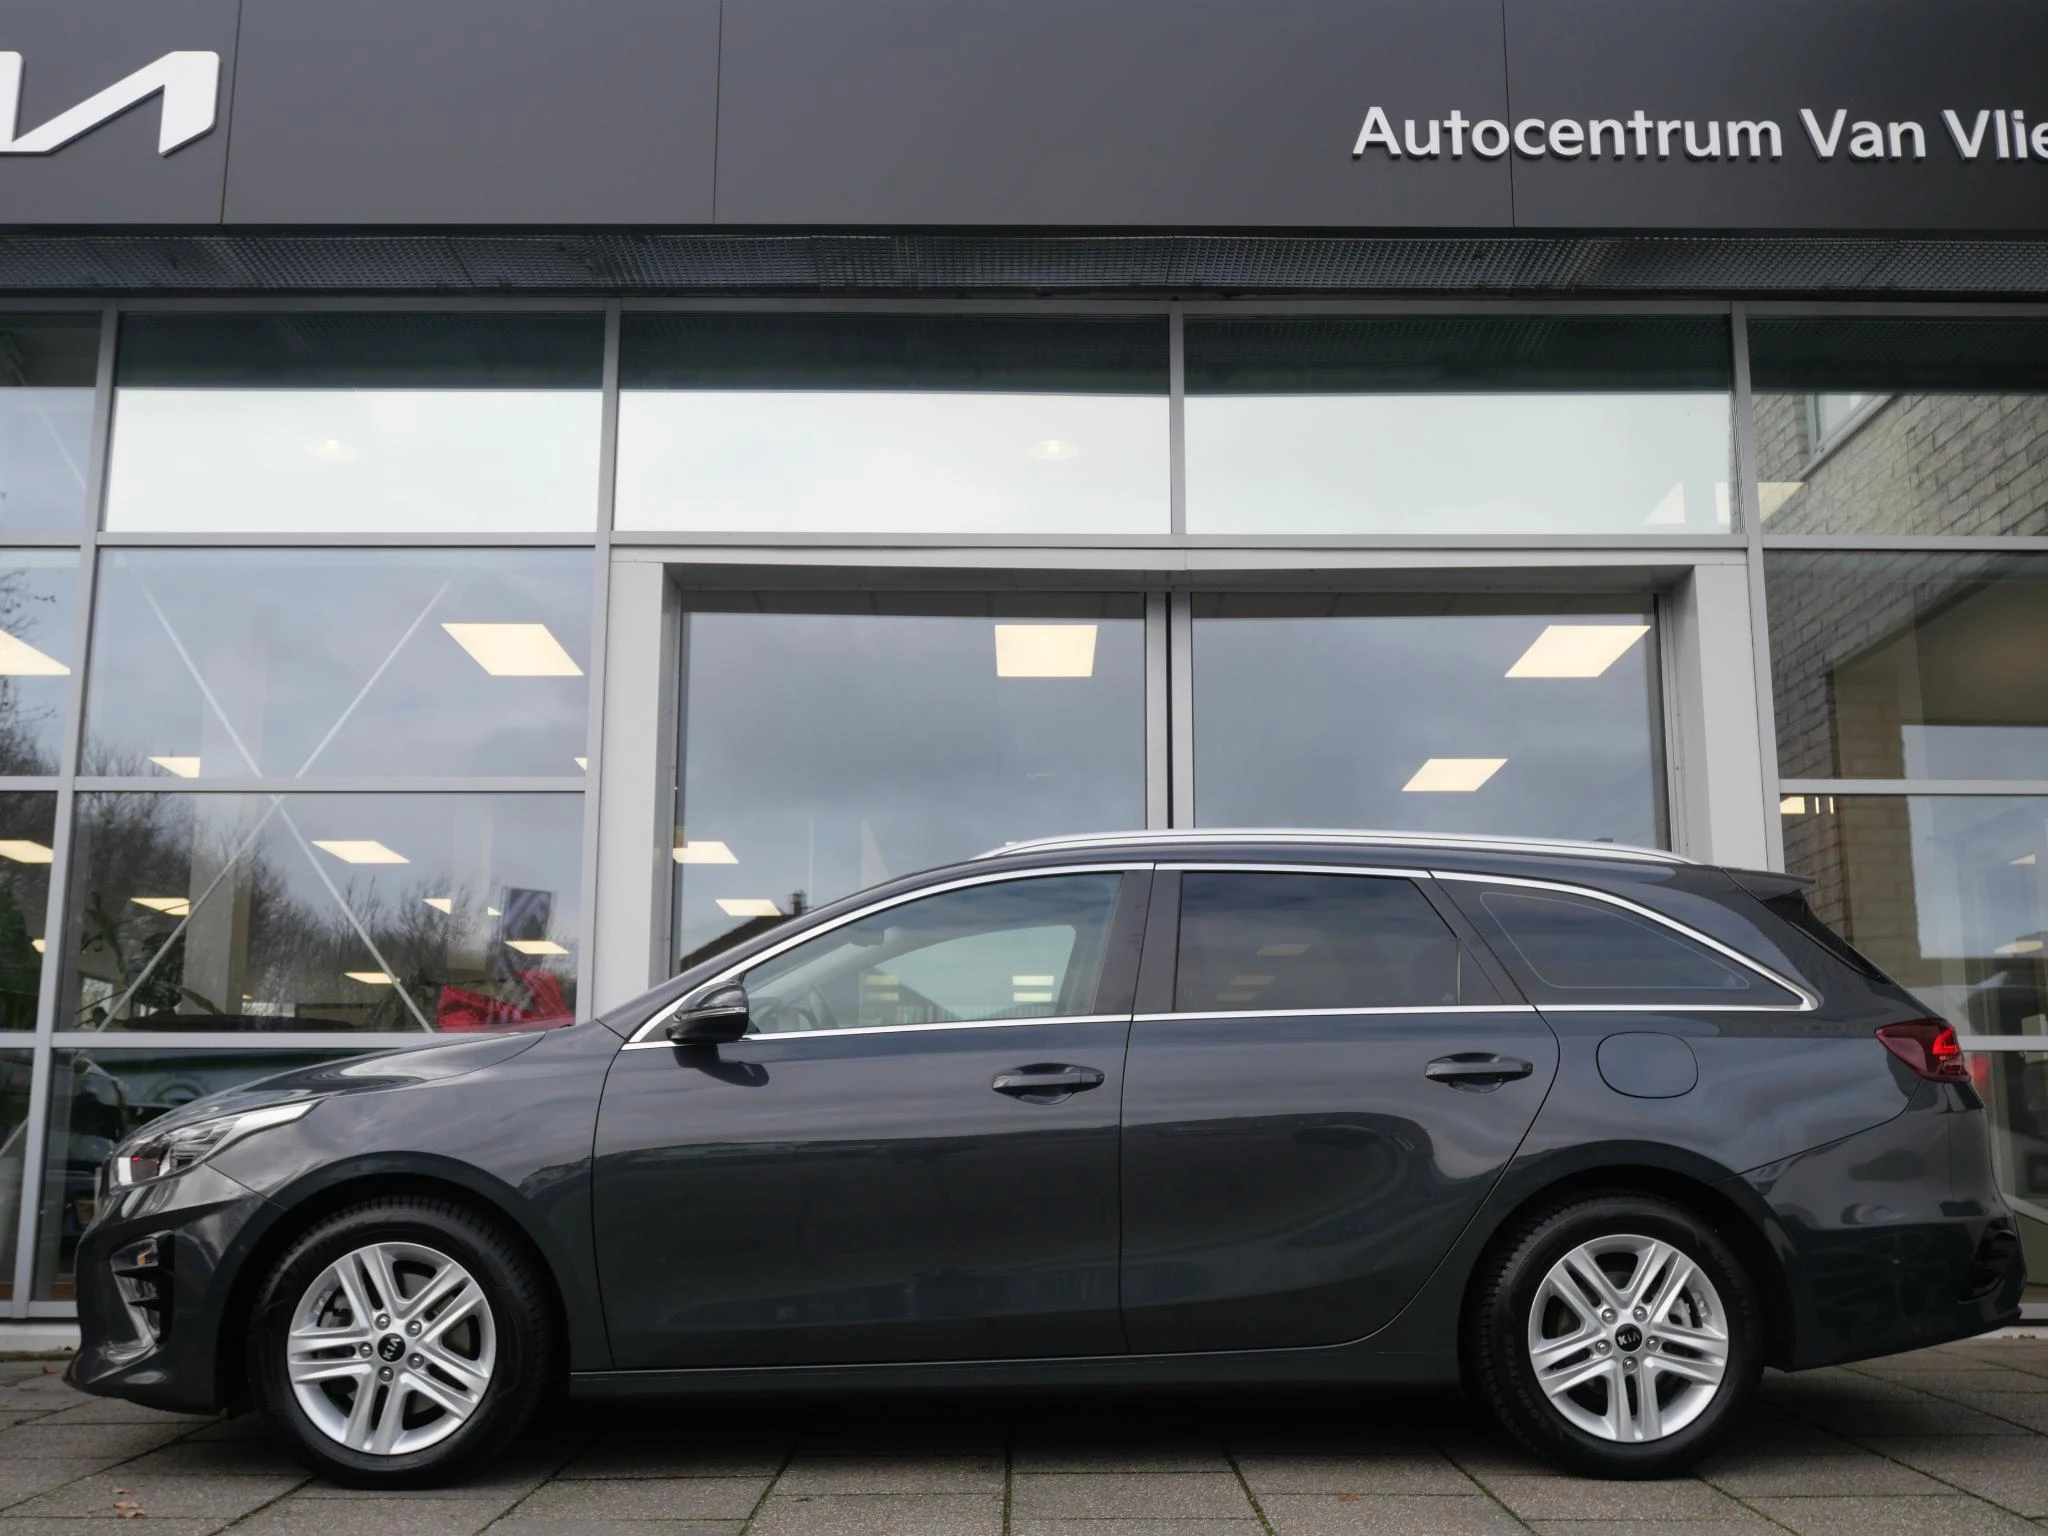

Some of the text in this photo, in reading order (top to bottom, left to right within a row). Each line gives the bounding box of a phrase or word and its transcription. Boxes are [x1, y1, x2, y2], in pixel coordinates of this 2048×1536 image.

[1352, 106, 1783, 158] Autocentrum
[1798, 108, 1926, 159] Van
[382, 1338, 401, 1360] KIA
[1618, 1332, 1641, 1346] KIA
